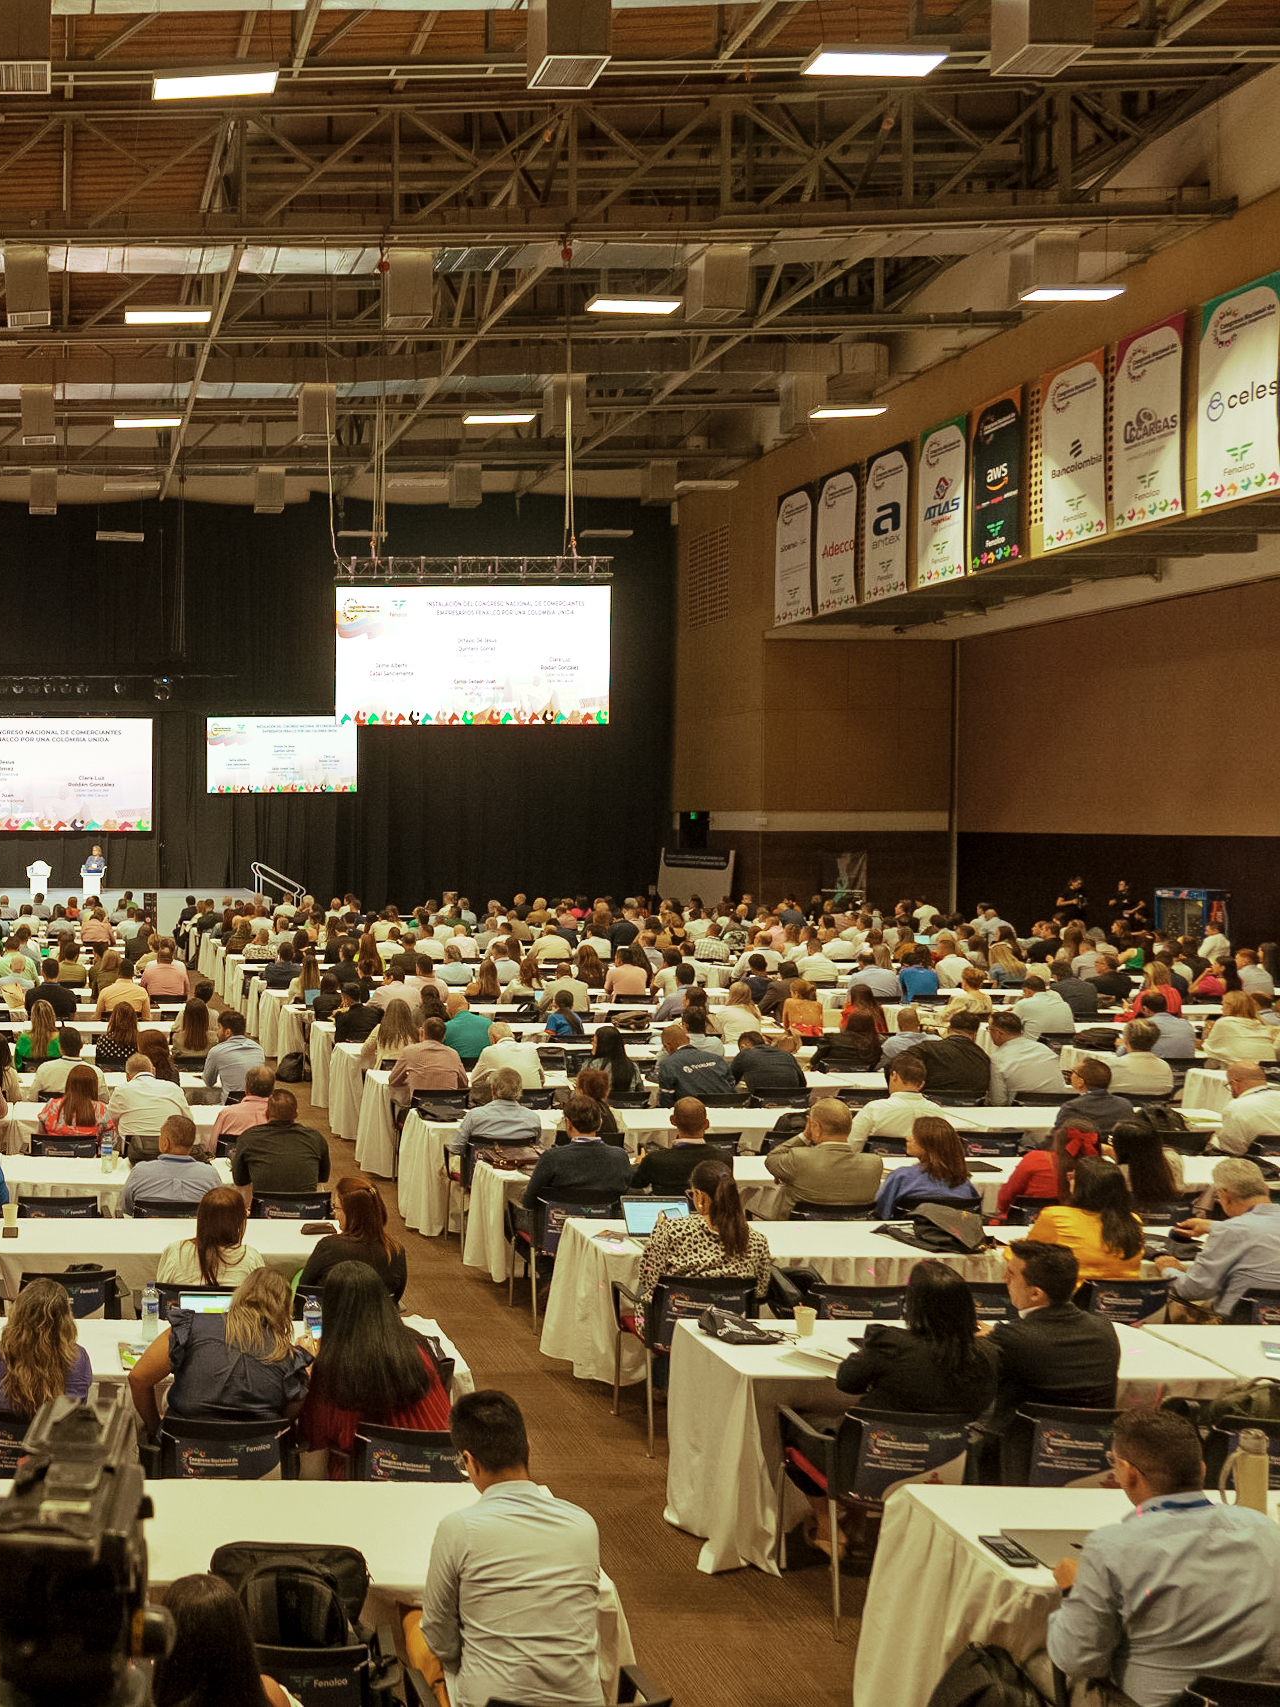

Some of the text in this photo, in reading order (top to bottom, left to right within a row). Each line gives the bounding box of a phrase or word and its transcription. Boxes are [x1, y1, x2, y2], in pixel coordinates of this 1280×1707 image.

[986, 462, 1008, 482] aws
[1223, 462, 1256, 476] Fenalco
[1134, 488, 1160, 502] Fenalco
[924, 496, 961, 521] ATLAS
[821, 539, 855, 559] Adecco
[246, 1443, 271, 1453] Fenalco
[313, 1677, 348, 1688] Fenalco
